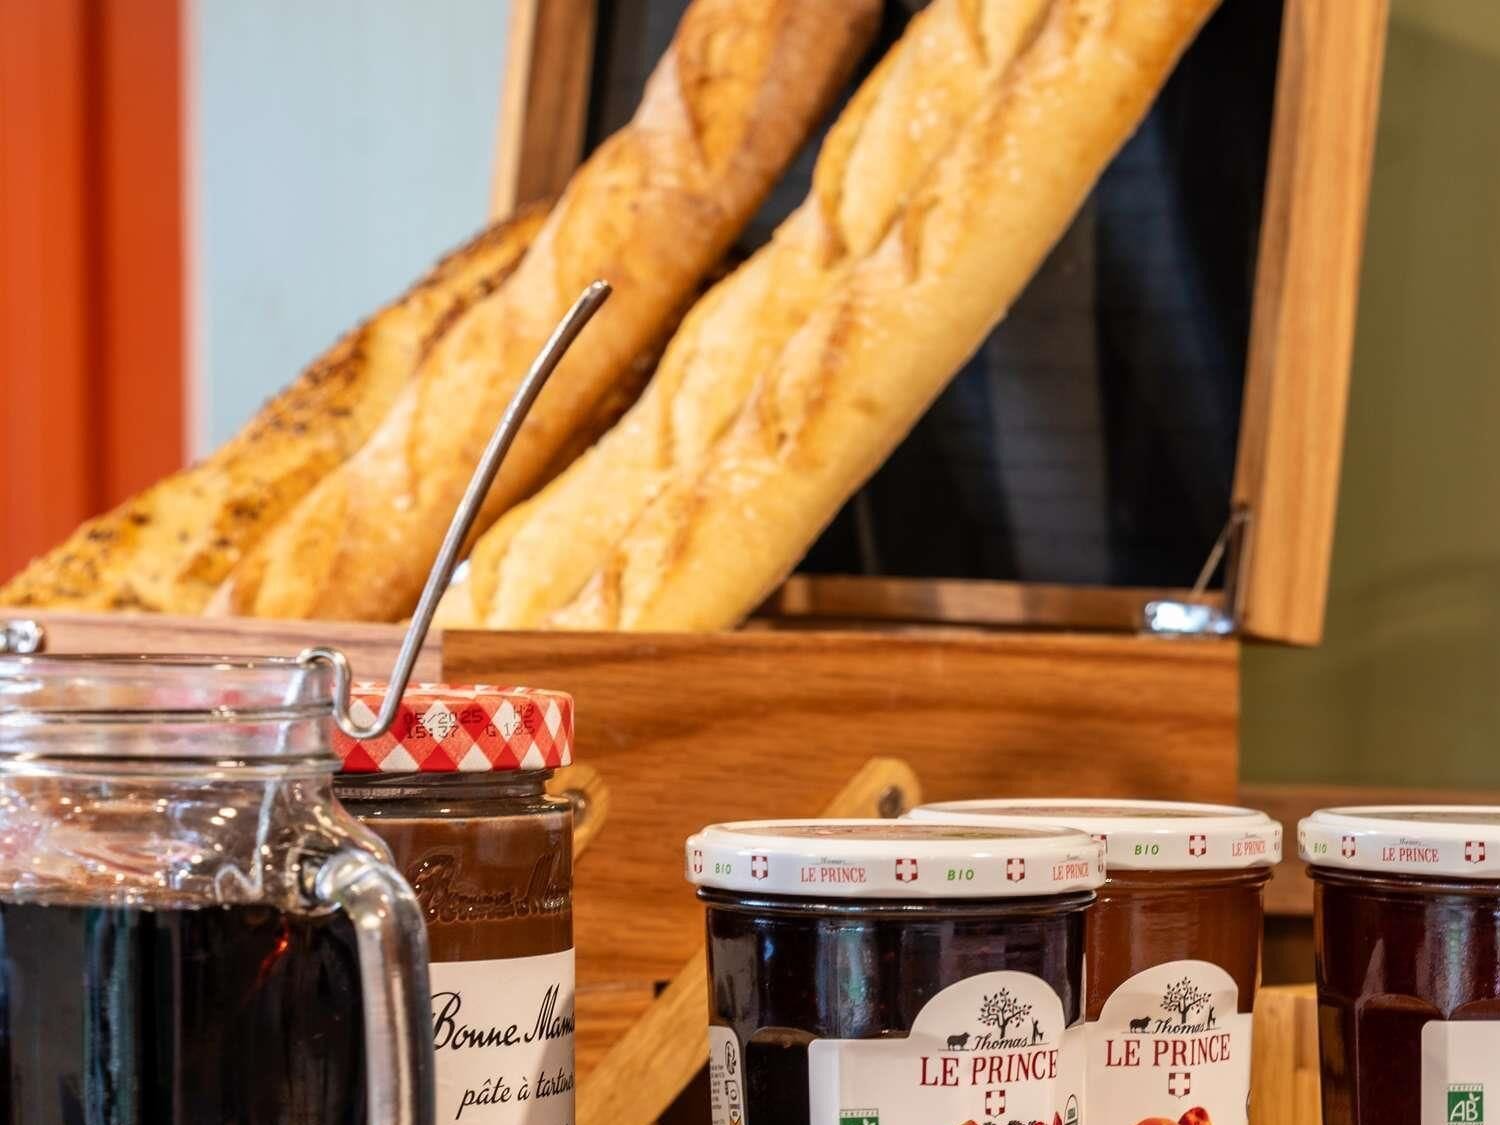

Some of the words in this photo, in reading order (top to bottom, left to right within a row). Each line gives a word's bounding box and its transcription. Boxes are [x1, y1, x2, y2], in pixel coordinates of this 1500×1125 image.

[1135, 845, 1159, 856] BIO
[1232, 842, 1243, 857] LE
[1382, 847, 1397, 862] LE
[1400, 847, 1439, 863] PRINCE
[715, 863, 732, 875] BIO
[801, 867, 816, 882] LE
[821, 867, 867, 883] PRINCE
[946, 869, 975, 881] BIO
[1053, 865, 1063, 881] LE
[431, 991, 520, 1051] Bonne
[1151, 1017, 1205, 1034] Thomas
[971, 1033, 1028, 1051] Thomas
[1105, 1039, 1140, 1067] LE
[1152, 1034, 1231, 1067] PRINCE
[920, 1056, 960, 1087] LE
[971, 1049, 1059, 1086] PRINCE
[455, 1077, 511, 1120] pâte
[517, 1076, 530, 1101] à
[1450, 1100, 1479, 1121] AB
